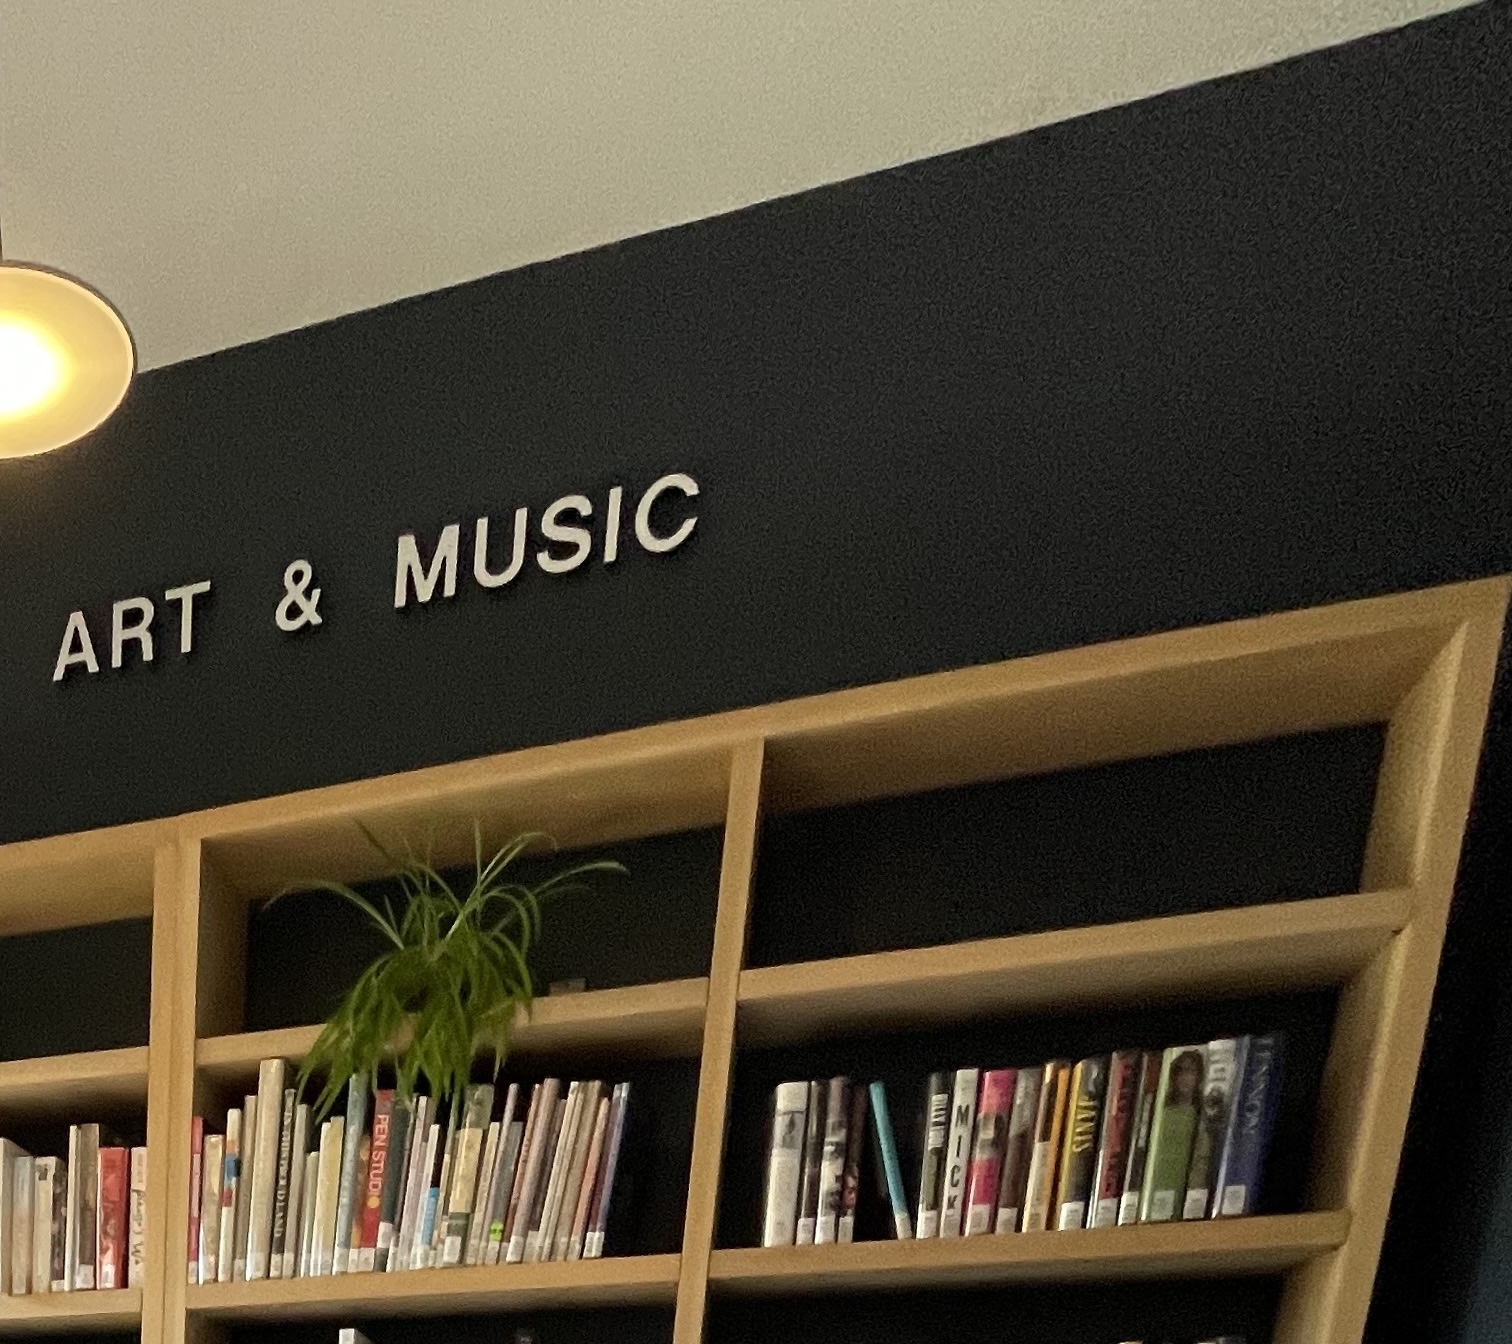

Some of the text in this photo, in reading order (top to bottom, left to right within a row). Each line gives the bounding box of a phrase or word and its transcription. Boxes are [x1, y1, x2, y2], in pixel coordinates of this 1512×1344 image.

[52, 472, 700, 682] ART & MUSIC
[947, 1105, 969, 1210] MICK
